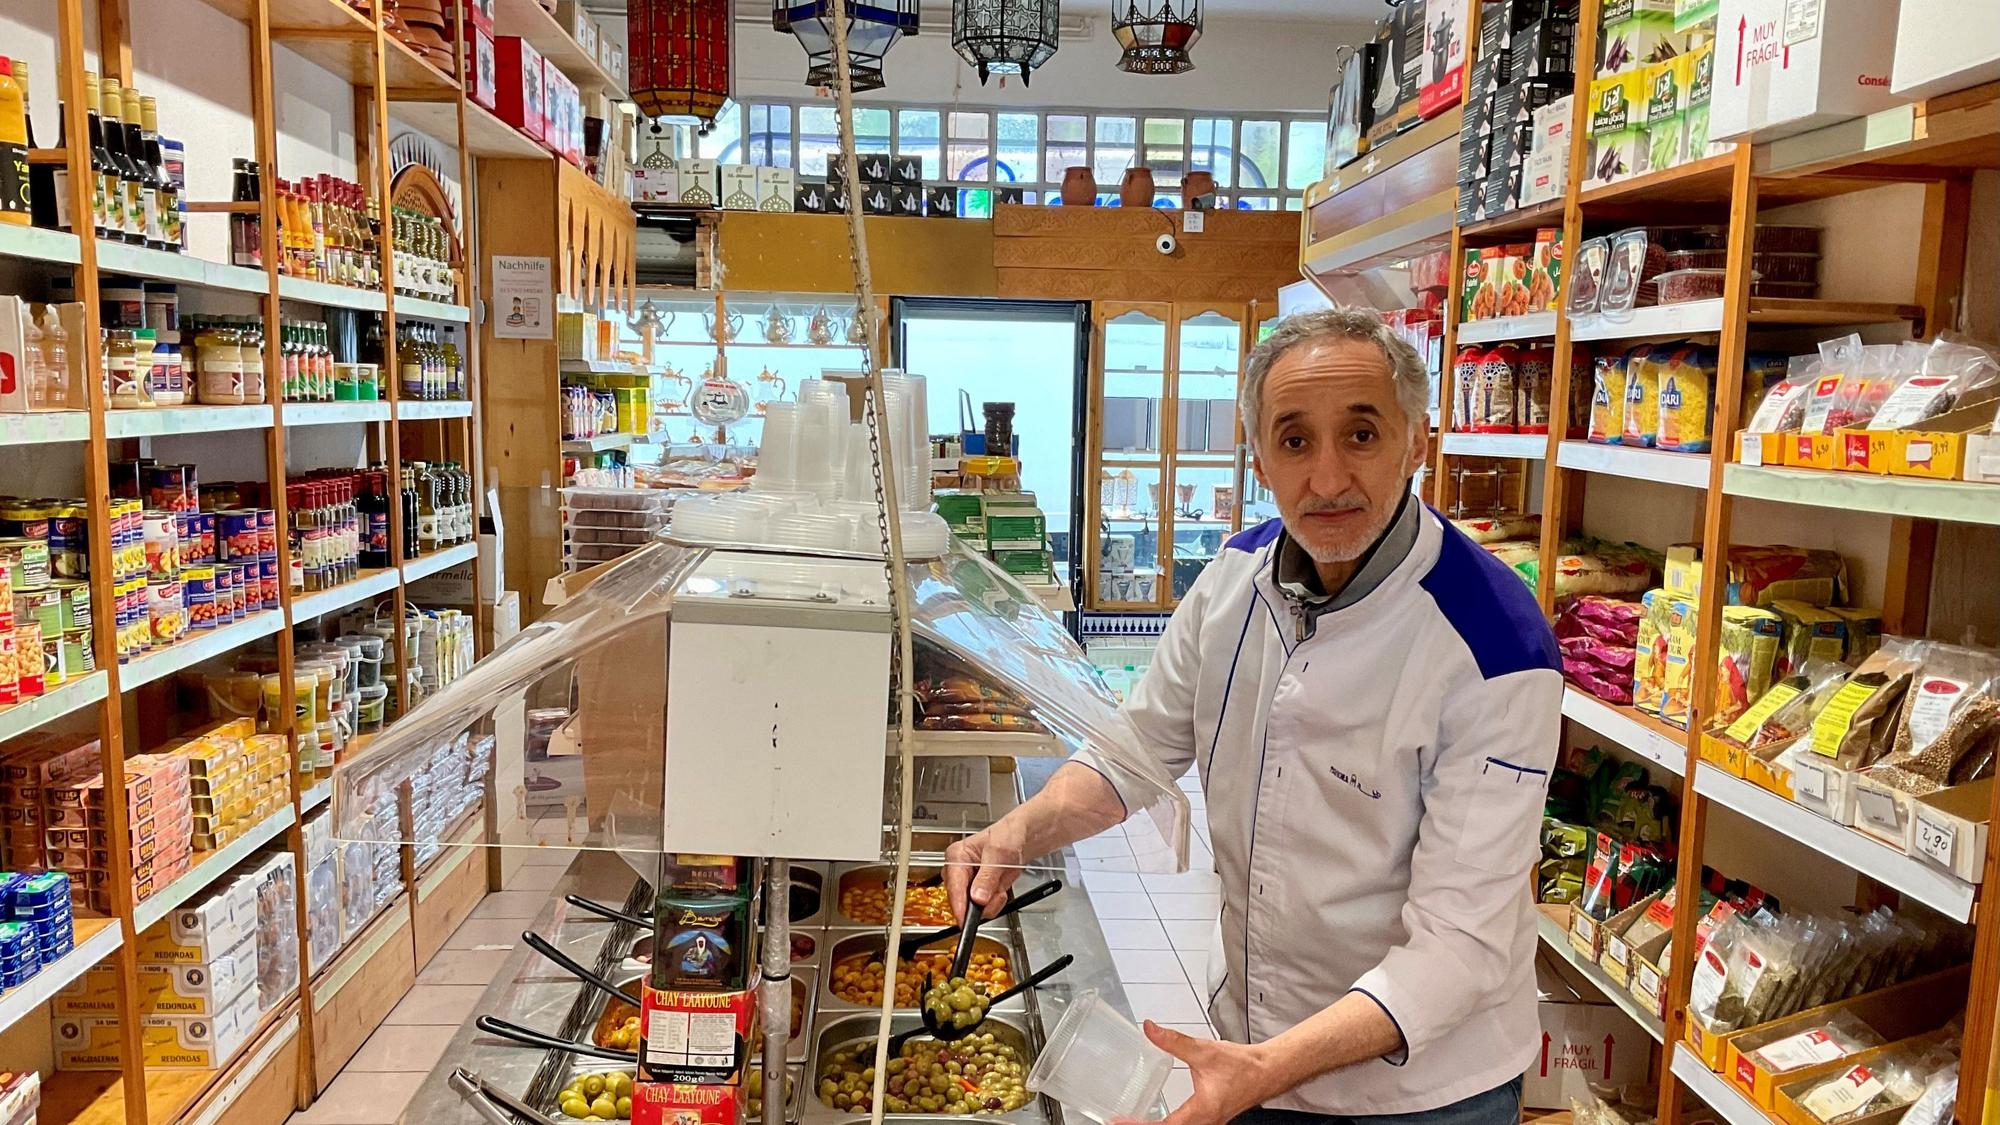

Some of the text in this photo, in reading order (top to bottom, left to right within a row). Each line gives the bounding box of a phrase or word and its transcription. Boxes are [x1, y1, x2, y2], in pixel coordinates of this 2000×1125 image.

[1753, 21, 1776, 44] MUY
[1746, 42, 1780, 68] FRÁGIL
[499, 260, 545, 271] Nachhilfe
[1661, 393, 1680, 406] DARI
[1923, 827, 1948, 850] 2,90
[155, 951, 194, 961] REDONDAS
[66, 1001, 197, 1010] MAGDALENAS REDONDAS
[656, 991, 732, 1009] CHAY LAAYOUNE
[1562, 1044, 1592, 1056] MUY
[71, 1055, 201, 1064] MAGDALENAS REDONDAS
[1554, 1057, 1598, 1070] FRÁGIL
[645, 1087, 721, 1105] CHAY LAAYOUNE
